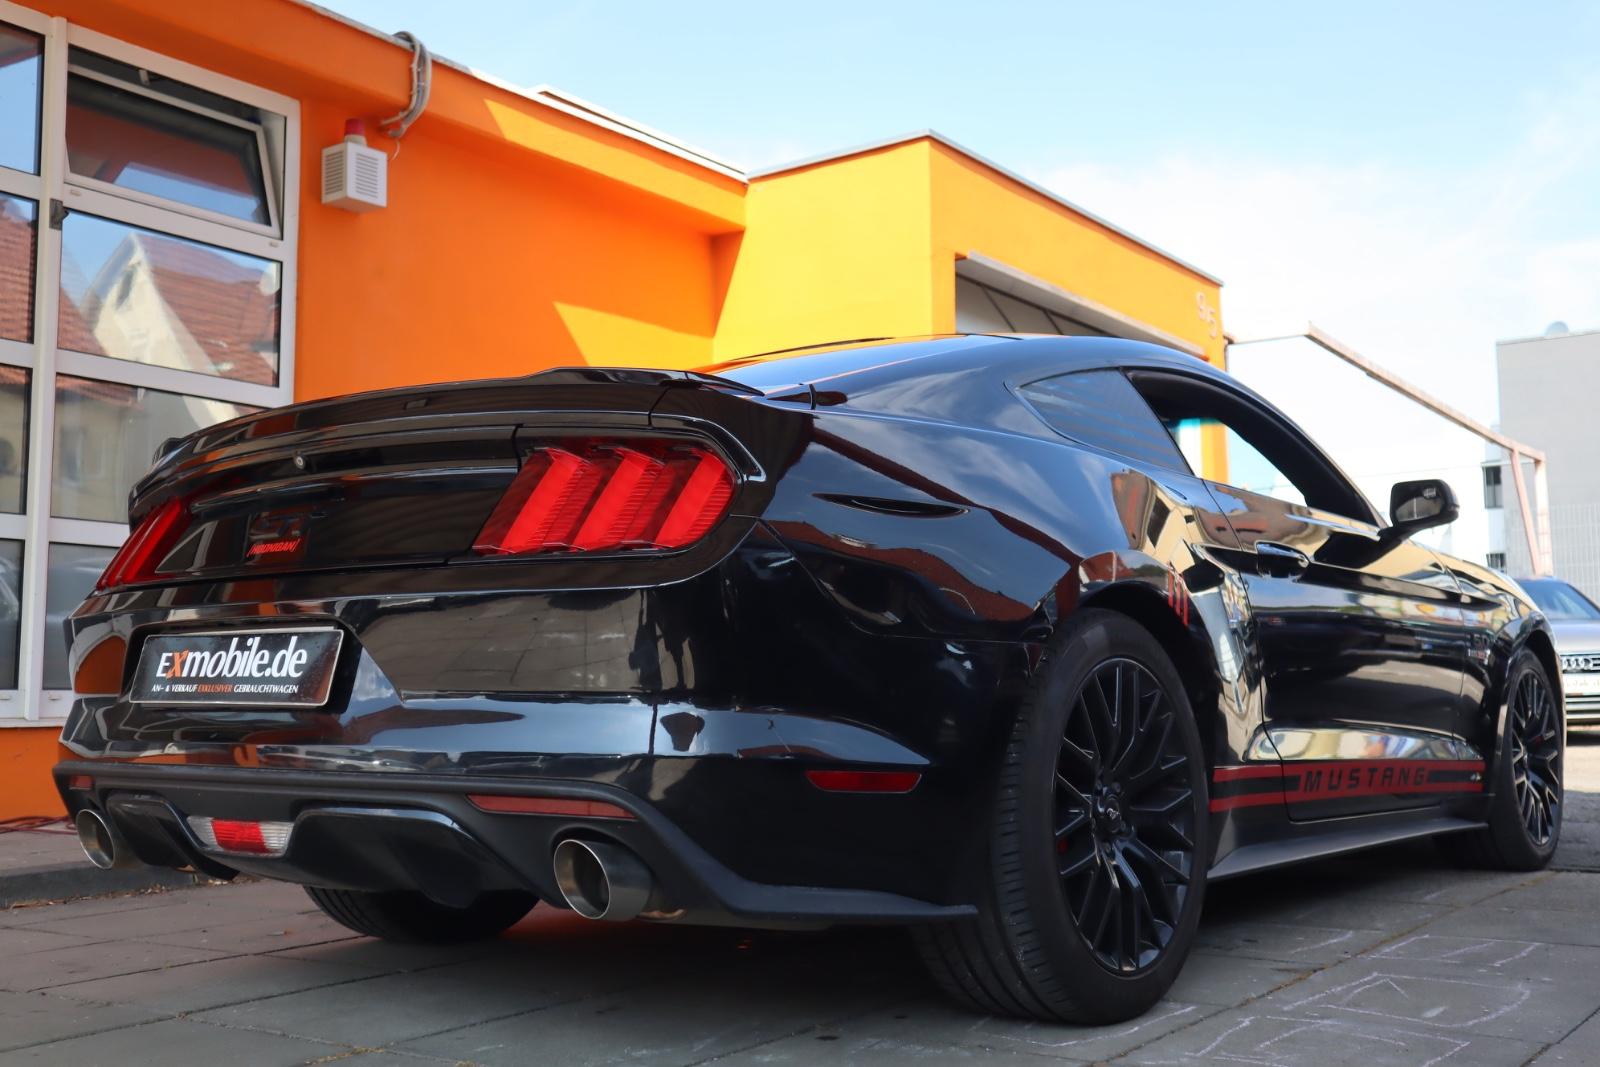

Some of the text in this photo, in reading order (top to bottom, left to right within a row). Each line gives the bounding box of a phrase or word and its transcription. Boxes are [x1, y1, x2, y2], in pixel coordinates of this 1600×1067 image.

[156, 635, 307, 680] EXmobile.de
[171, 684, 197, 693] VERKAUF
[197, 684, 232, 693] EXKLUSIVER
[234, 684, 298, 693] GEBRAUCHTWAGEN
[1304, 767, 1425, 793] MUSTANG
